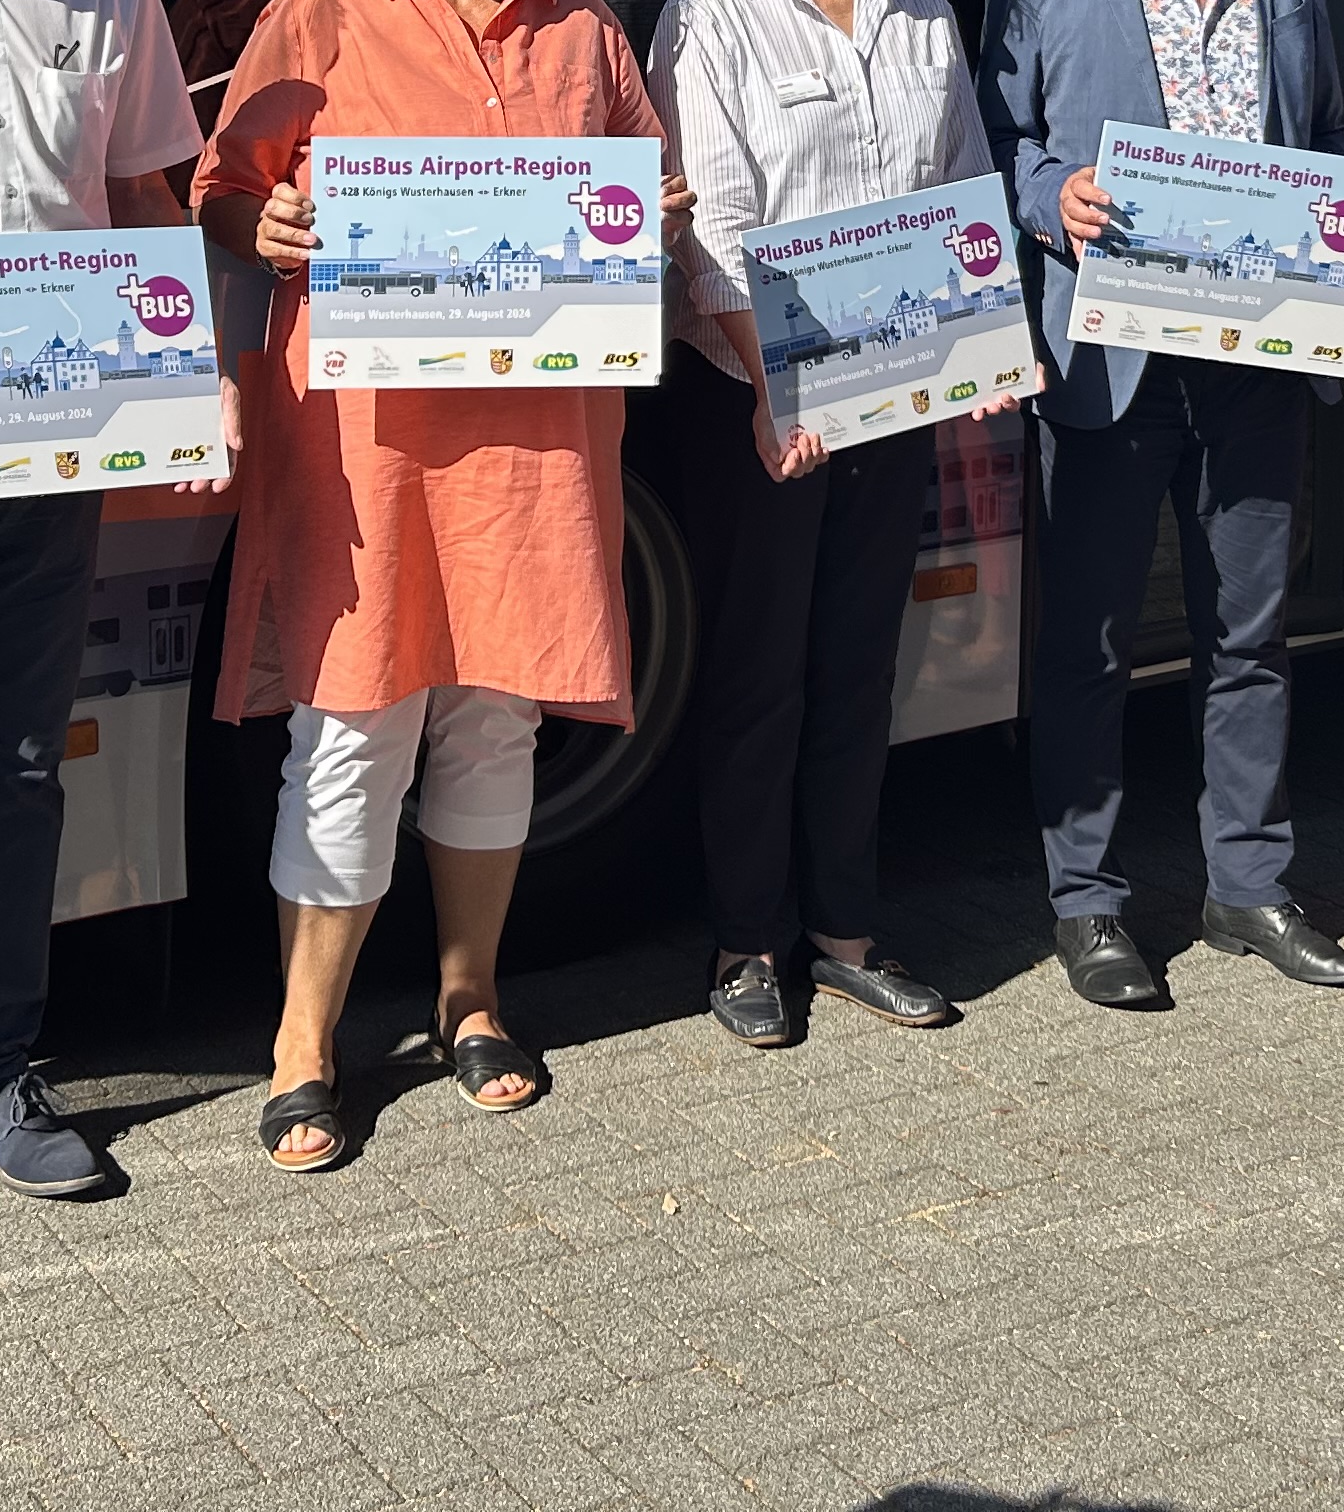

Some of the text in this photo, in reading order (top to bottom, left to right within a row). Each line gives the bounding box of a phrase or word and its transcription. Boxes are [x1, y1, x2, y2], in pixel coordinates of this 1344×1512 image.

[325, 156, 591, 180] PlusBus Airport-Region
[1112, 140, 1333, 188] PlusBus Airport-Region
[341, 186, 527, 199] 428 Königs Wusterhausen Erkner
[755, 205, 957, 265] PlusBus Airport-Region
[40, 282, 75, 293] Erkner
[330, 308, 531, 322] Königs Wusterhausen, 29. August 2024
[548, 357, 573, 368] RVS
[27, 410, 65, 425] August
[67, 408, 93, 419] 2024
[114, 456, 140, 467] RVS
